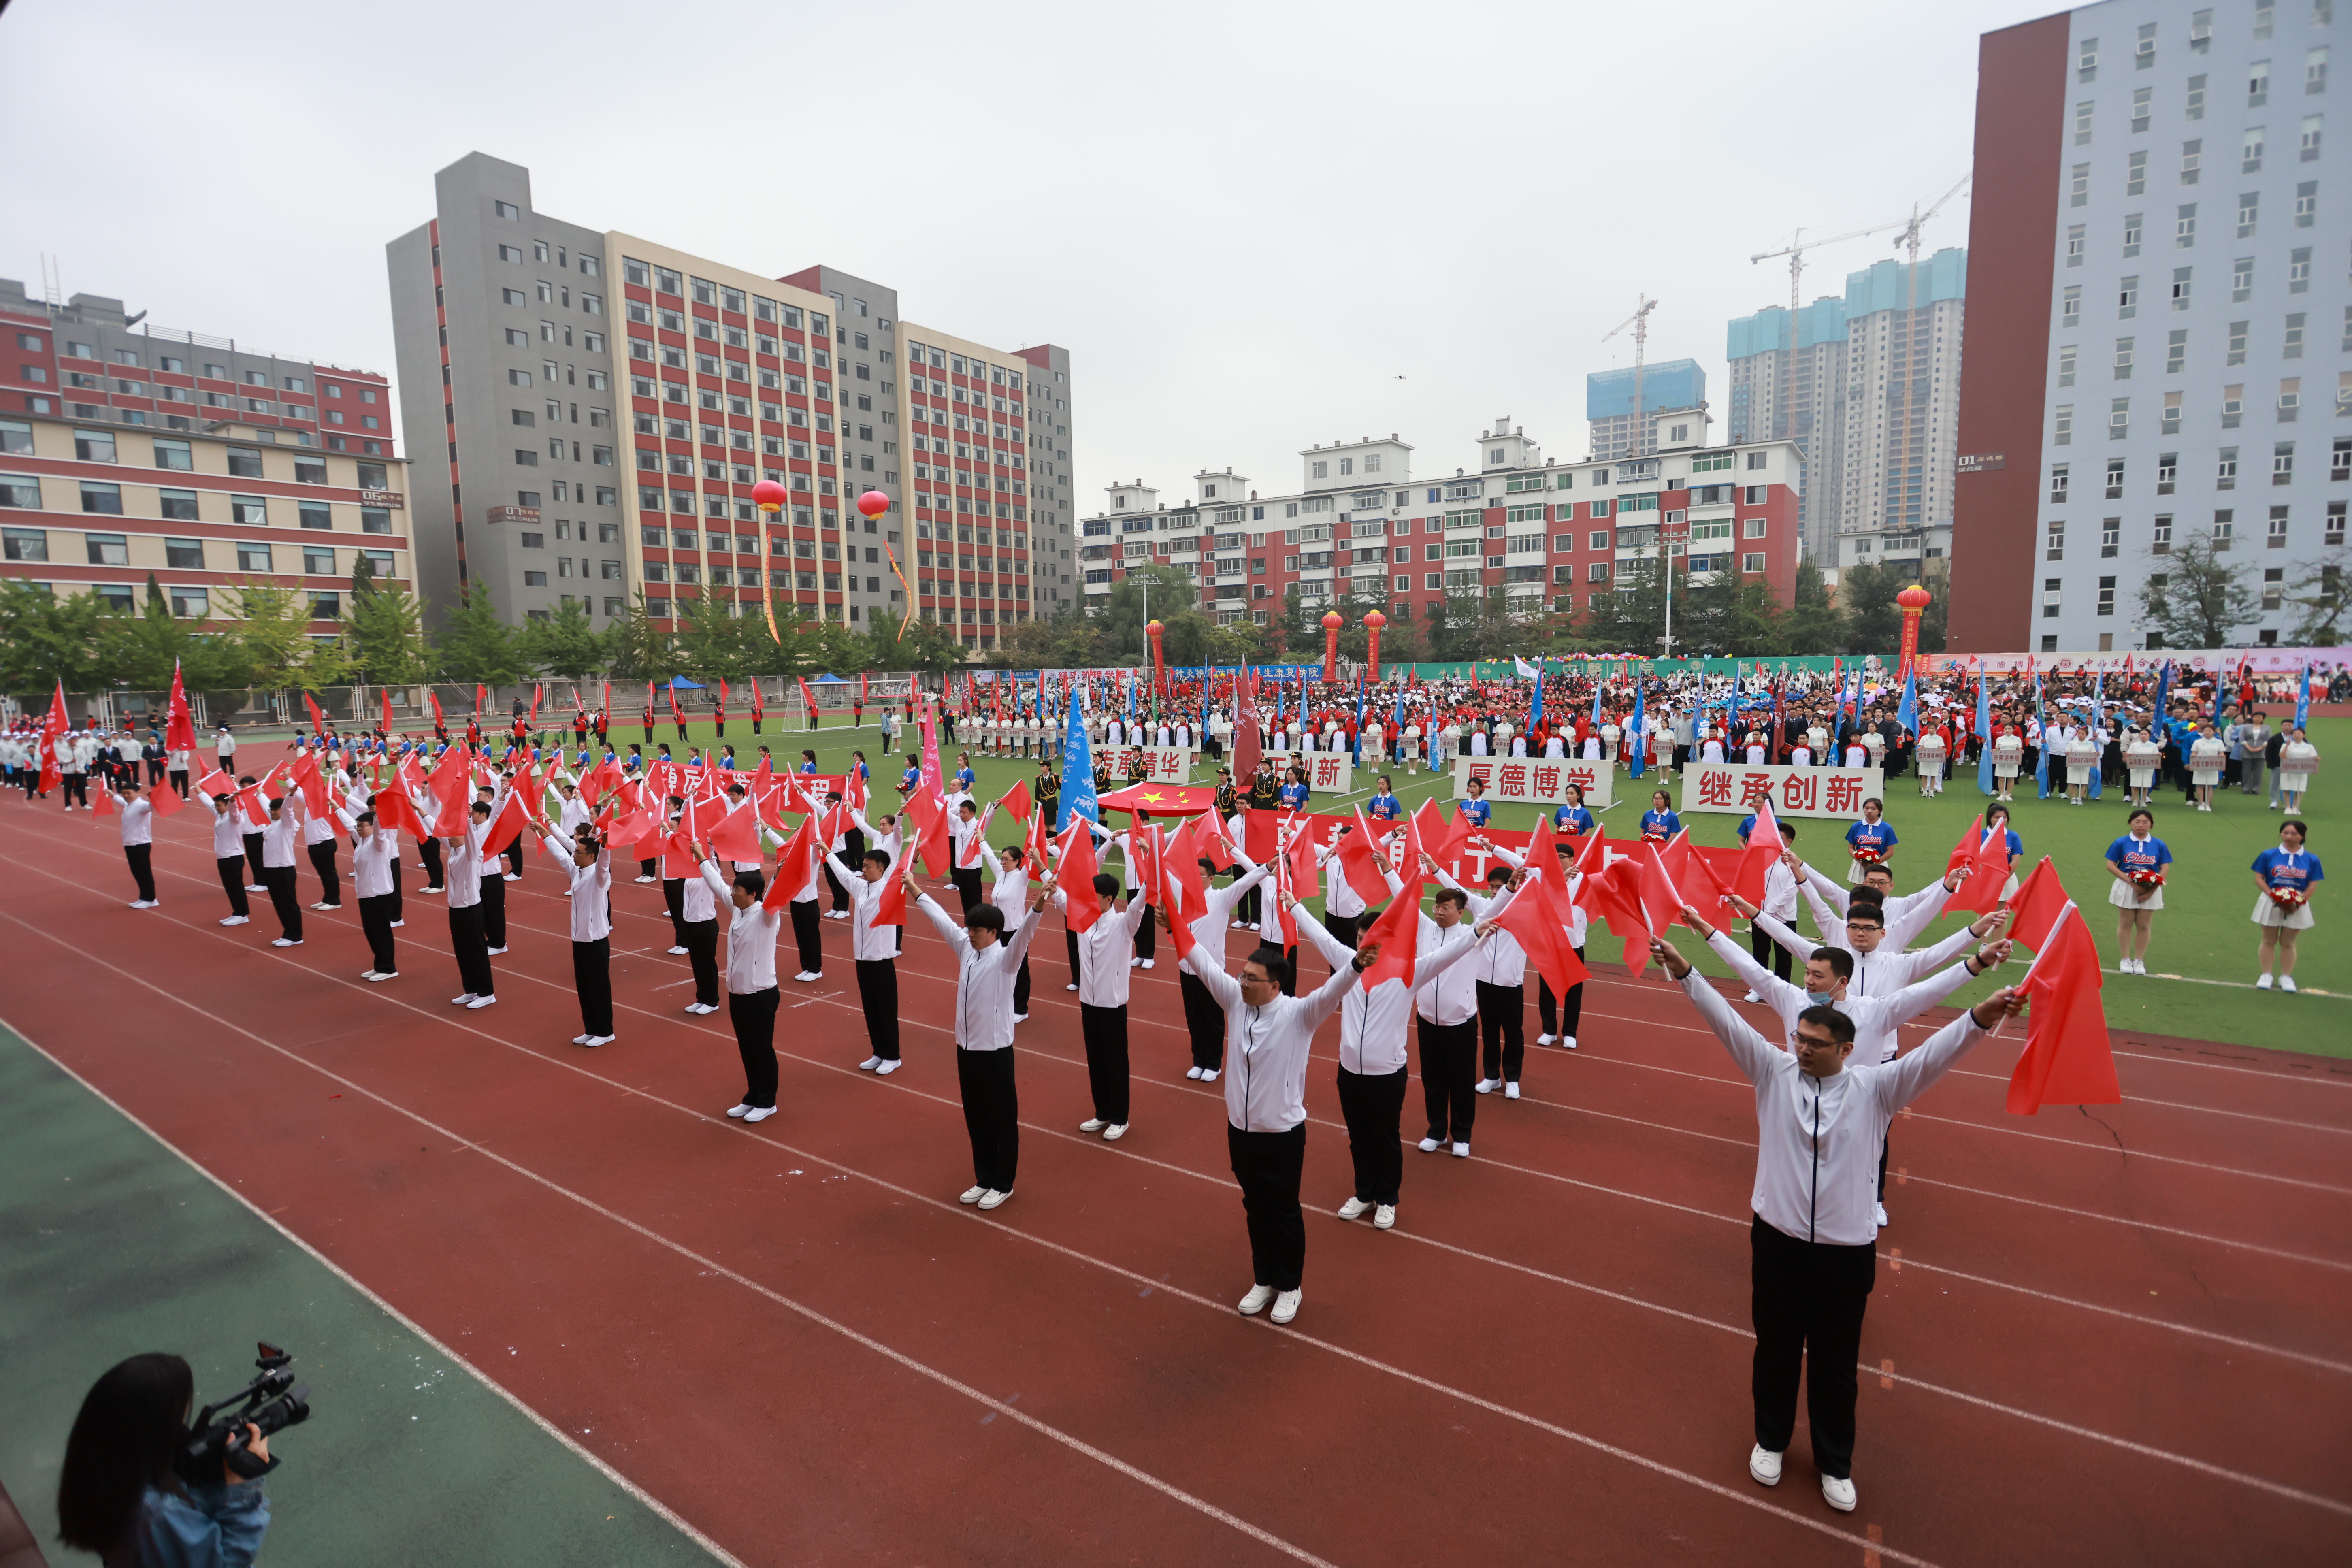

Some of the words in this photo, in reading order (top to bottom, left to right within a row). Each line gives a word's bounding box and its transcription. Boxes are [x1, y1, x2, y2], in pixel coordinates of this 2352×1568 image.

[1958, 455, 1975, 466] 01
[362, 491, 381, 501] 06
[505, 506, 522, 516] 07
[1467, 762, 1595, 799] 厚德博学
[1698, 770, 1864, 813] 继承创新
[1283, 795, 1298, 803] China
[1374, 804, 1390, 813] China
[1463, 809, 1481, 818] China
[1561, 816, 1580, 826] China
[1647, 822, 1668, 833] China
[1857, 835, 1882, 845] China
[2123, 852, 2156, 865] China
[2271, 865, 2307, 878] China
